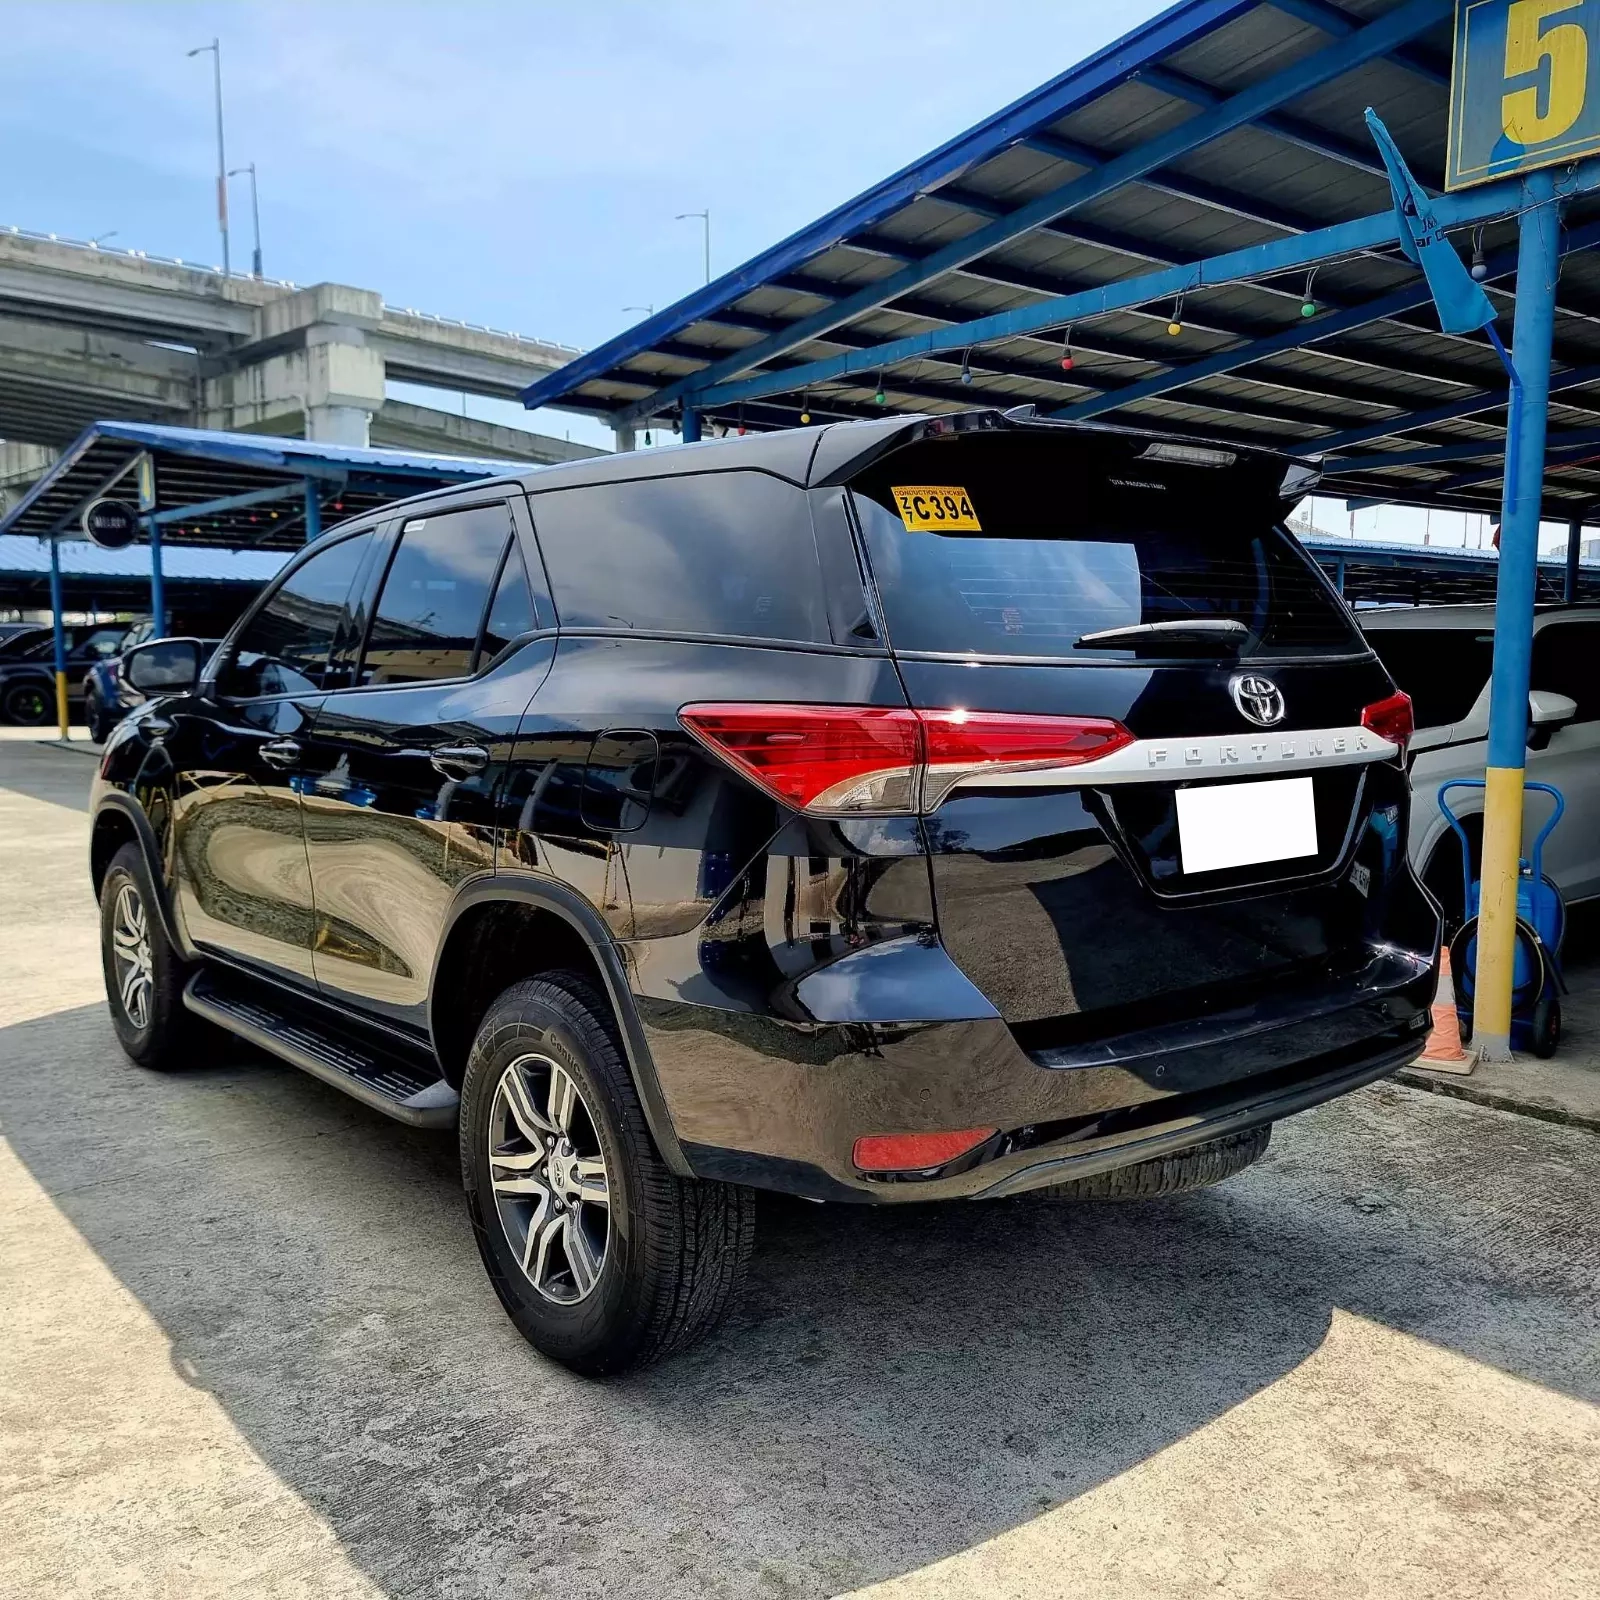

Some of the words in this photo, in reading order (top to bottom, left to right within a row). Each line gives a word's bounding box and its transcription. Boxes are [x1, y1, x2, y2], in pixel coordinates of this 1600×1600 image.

[1502, 0, 1588, 145] 5
[913, 496, 974, 520] C394
[1148, 734, 1369, 767] FORTUNER
